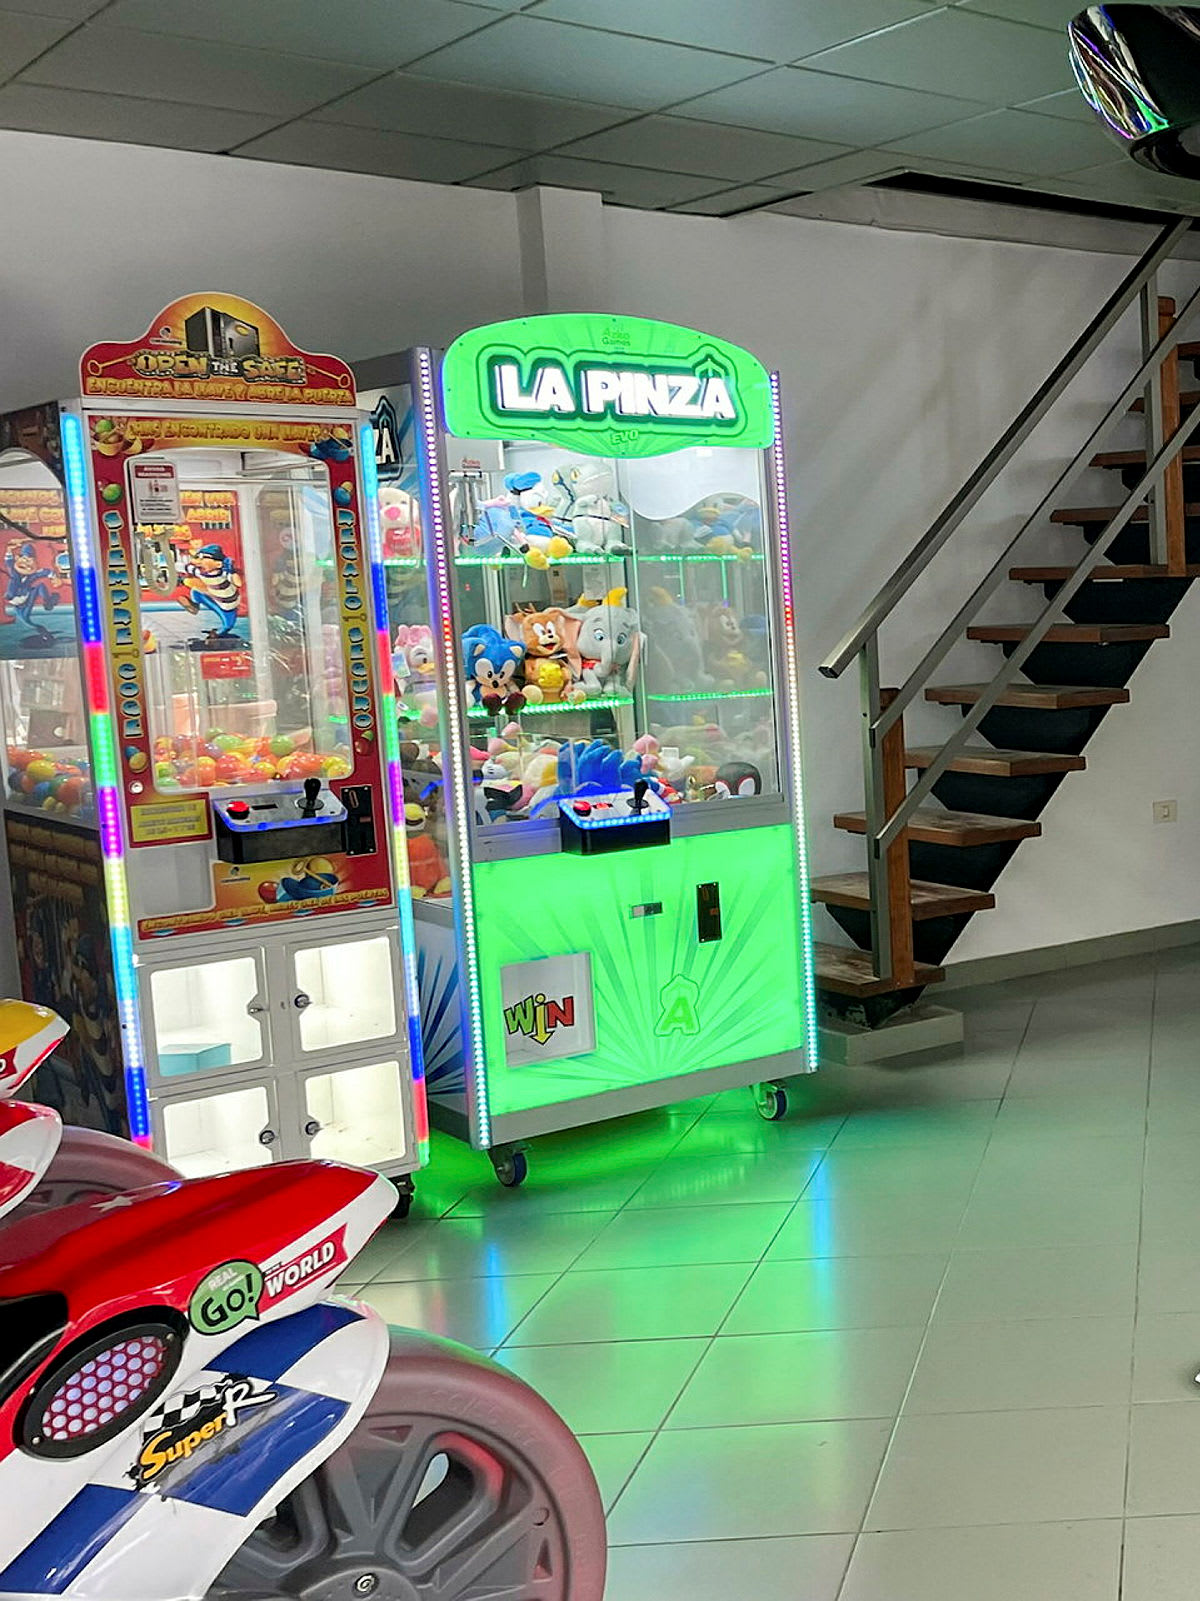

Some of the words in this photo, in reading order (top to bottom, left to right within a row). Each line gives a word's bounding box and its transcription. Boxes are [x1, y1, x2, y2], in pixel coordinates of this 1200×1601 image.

[135, 353, 208, 378] OPEN
[211, 360, 239, 375] THE
[243, 357, 304, 381] SAFE
[494, 364, 576, 413] LA
[581, 369, 737, 420] PINZA
[610, 430, 640, 445] EVO
[103, 511, 134, 646] SIEMPRE
[338, 509, 362, 611] REGALO
[118, 663, 143, 737] COGE
[348, 627, 373, 729] SEGURO
[208, 1267, 238, 1291] REAL
[265, 1241, 336, 1298] WORLD
[201, 1273, 254, 1327] GO!
[139, 1411, 228, 1480] Super
